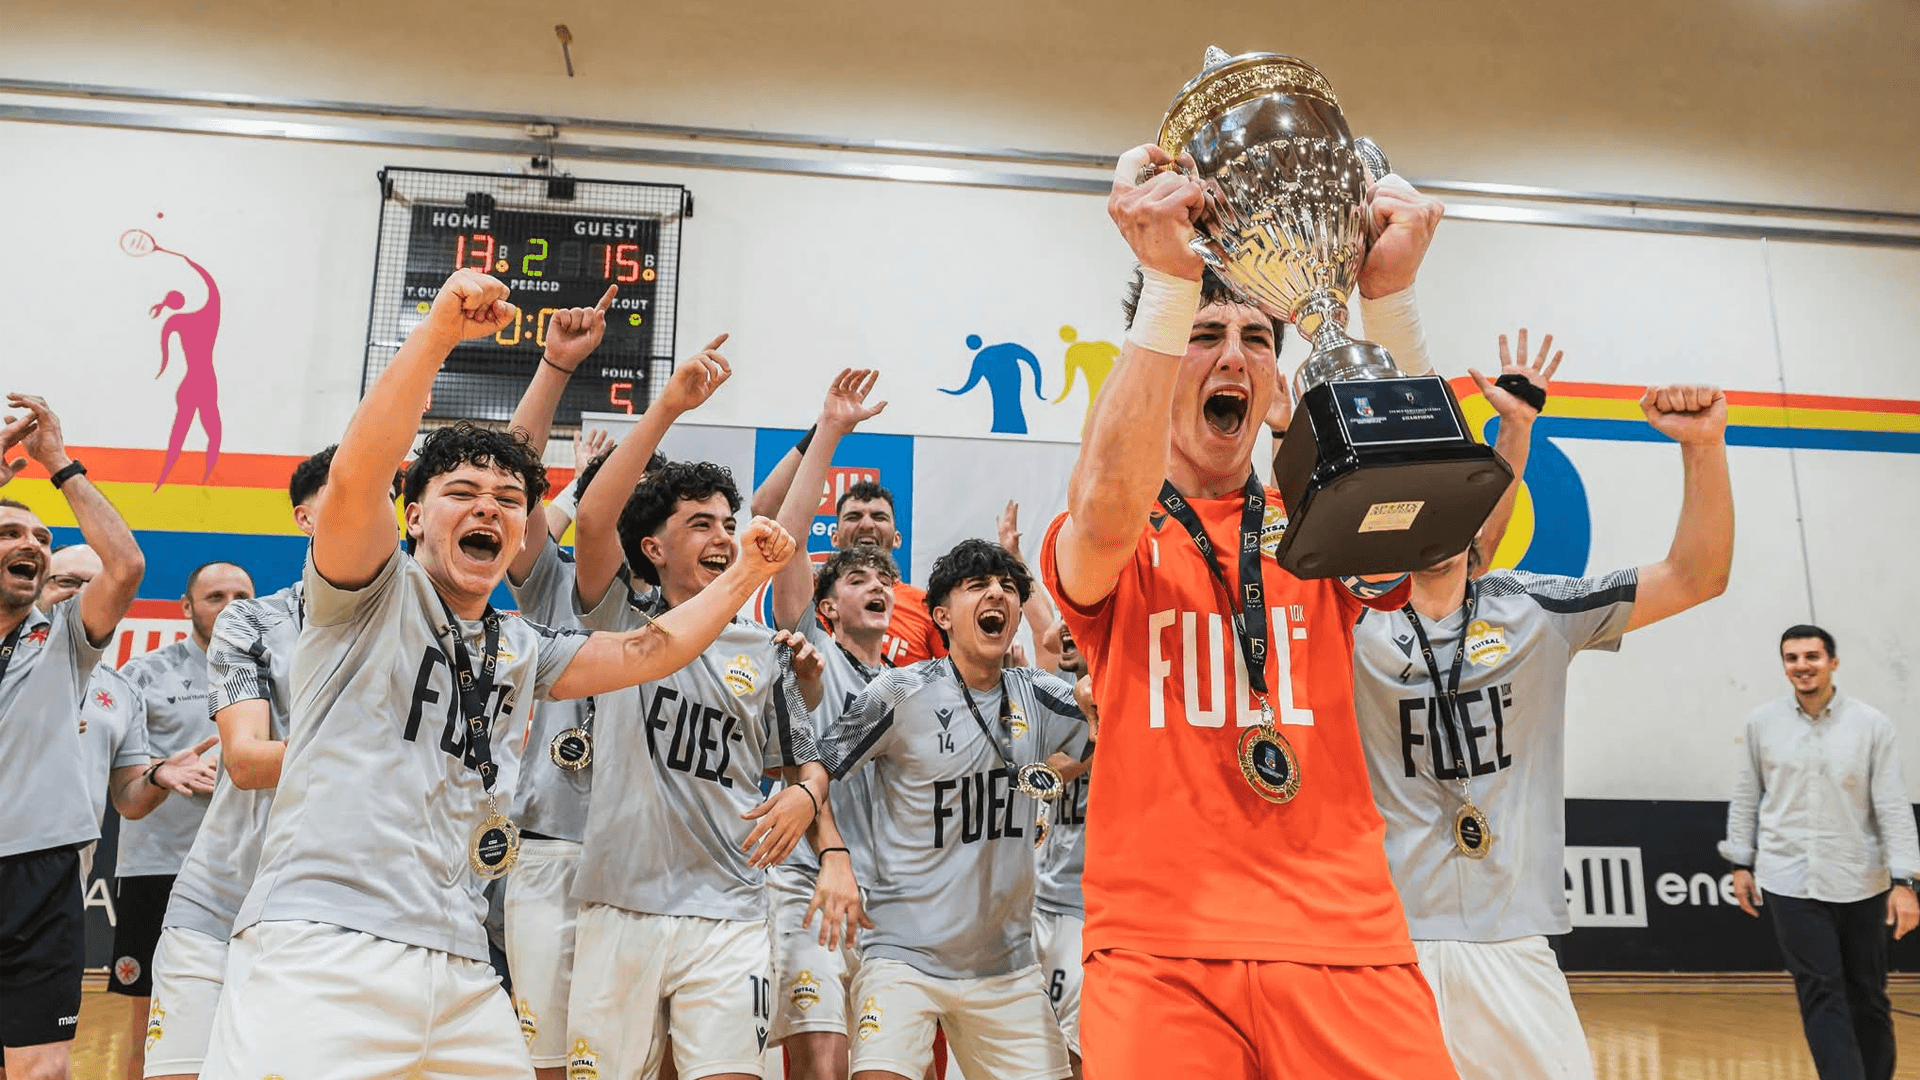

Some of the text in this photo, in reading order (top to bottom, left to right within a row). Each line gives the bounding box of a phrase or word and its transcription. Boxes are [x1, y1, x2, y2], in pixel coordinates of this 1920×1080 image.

[432, 212, 491, 230] HOME
[574, 220, 638, 239] GUEST
[455, 234, 495, 274] 13
[522, 238, 549, 277] 2
[603, 243, 641, 284] 15
[405, 286, 441, 298] T.OU
[510, 279, 561, 293] PERIOD
[601, 368, 645, 380] FOULS
[1248, 494, 1262, 507] 15
[1243, 531, 1258, 547] 15
[1244, 583, 1261, 600] 15
[1250, 637, 1265, 656] 15
[1471, 638, 1501, 651] FUTSAL
[486, 654, 496, 669] 15
[460, 669, 472, 685] 15
[469, 716, 483, 735] 15
[1398, 686, 1512, 780] FUEL
[647, 685, 740, 789] FUEL
[937, 733, 955, 754] 14
[933, 767, 1023, 849] FUEL
[1655, 872, 1764, 906] ene
[749, 974, 770, 1021] 10
